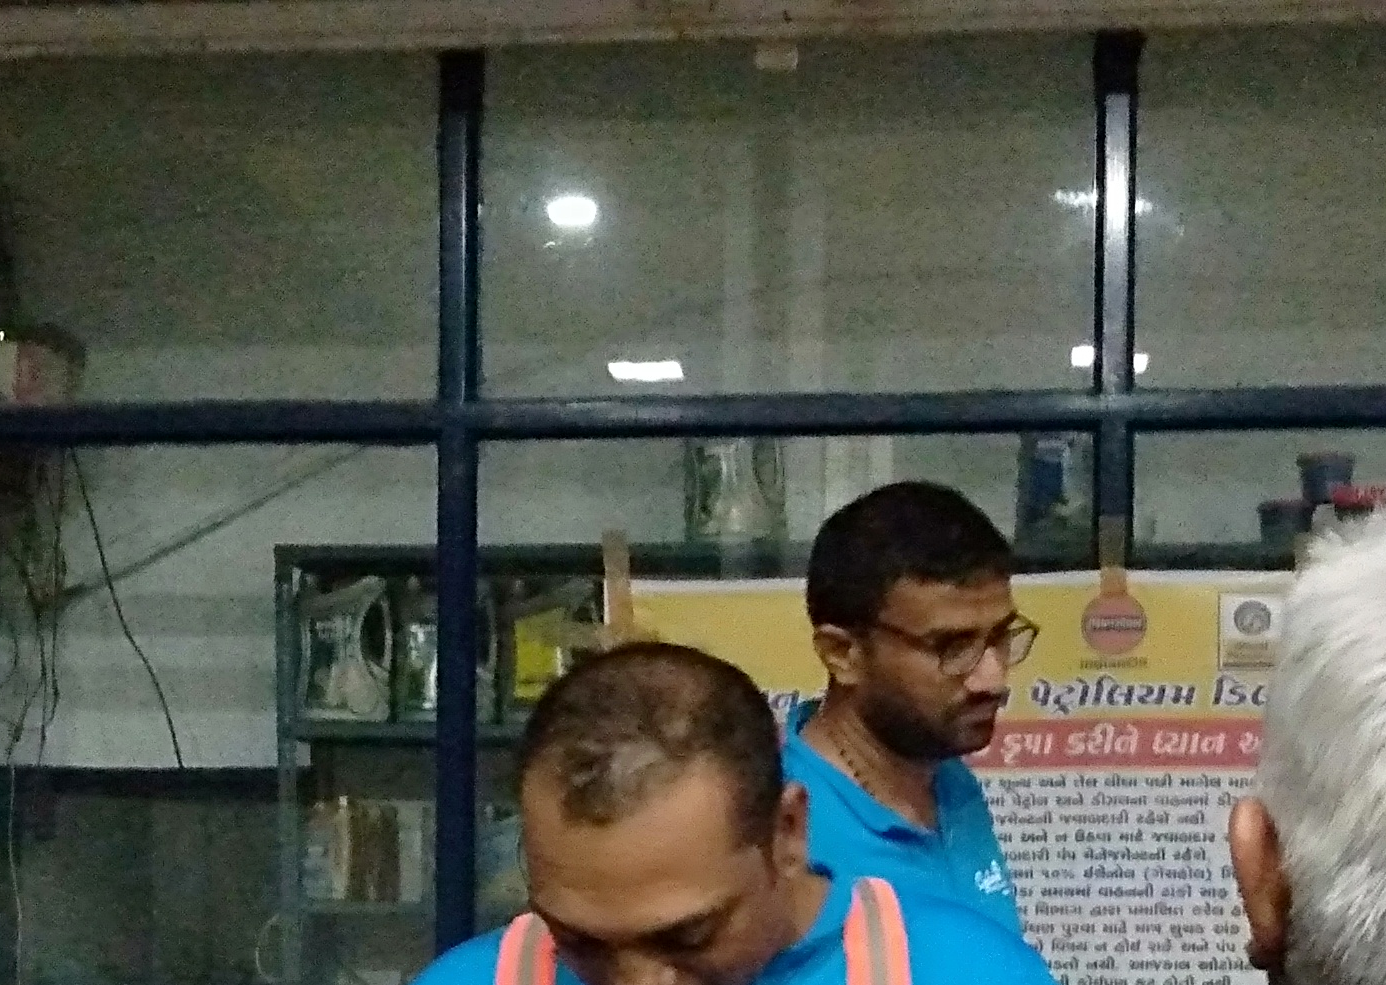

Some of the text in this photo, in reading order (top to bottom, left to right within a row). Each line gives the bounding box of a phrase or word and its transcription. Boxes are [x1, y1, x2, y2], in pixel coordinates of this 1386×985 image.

[1031, 674, 1196, 715] પેટ્રોલિયમ
[1001, 731, 1053, 765] કૃપા
[1067, 722, 1139, 755] કરીને
[1152, 731, 1227, 755] ધ્યાન
